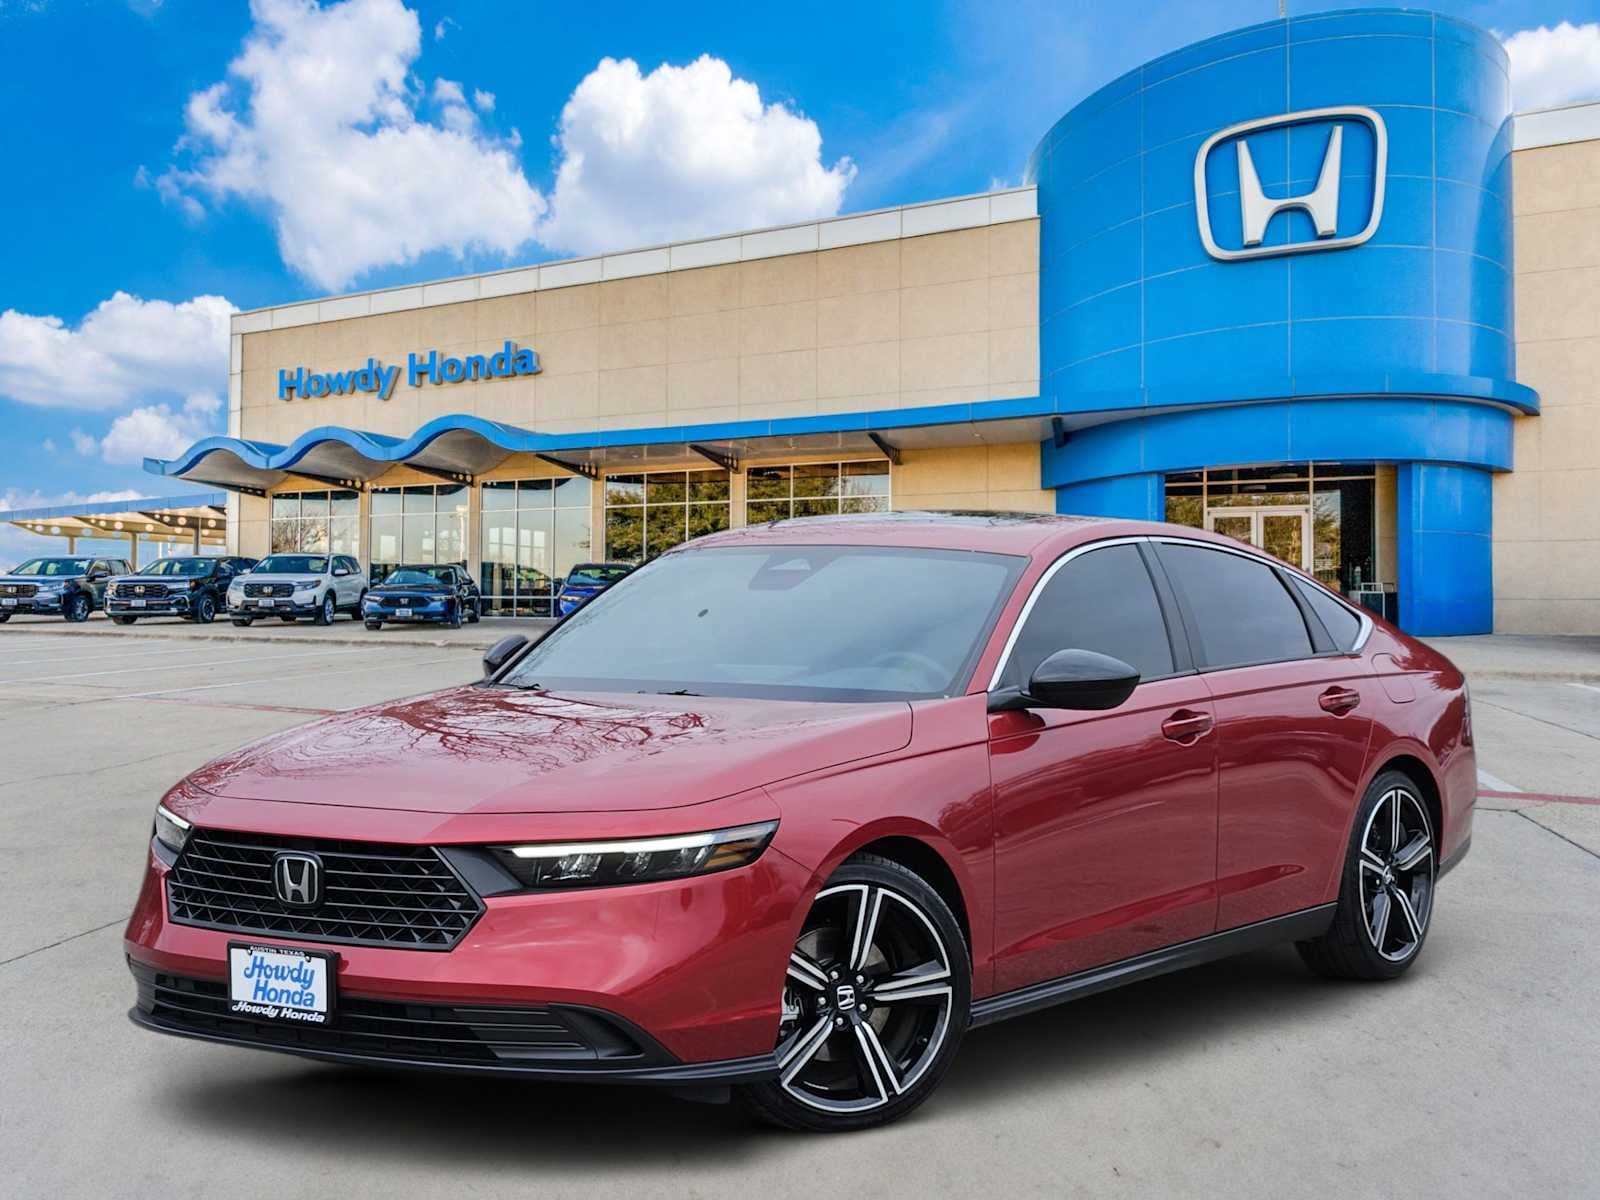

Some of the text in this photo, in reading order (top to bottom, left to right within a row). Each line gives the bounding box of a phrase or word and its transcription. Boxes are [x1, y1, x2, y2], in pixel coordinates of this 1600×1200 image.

[278, 340, 541, 401] Howdy Honda
[243, 954, 315, 990] Howdy
[253, 979, 316, 1007] Honda
[231, 1001, 326, 1023] Howdy Honda
